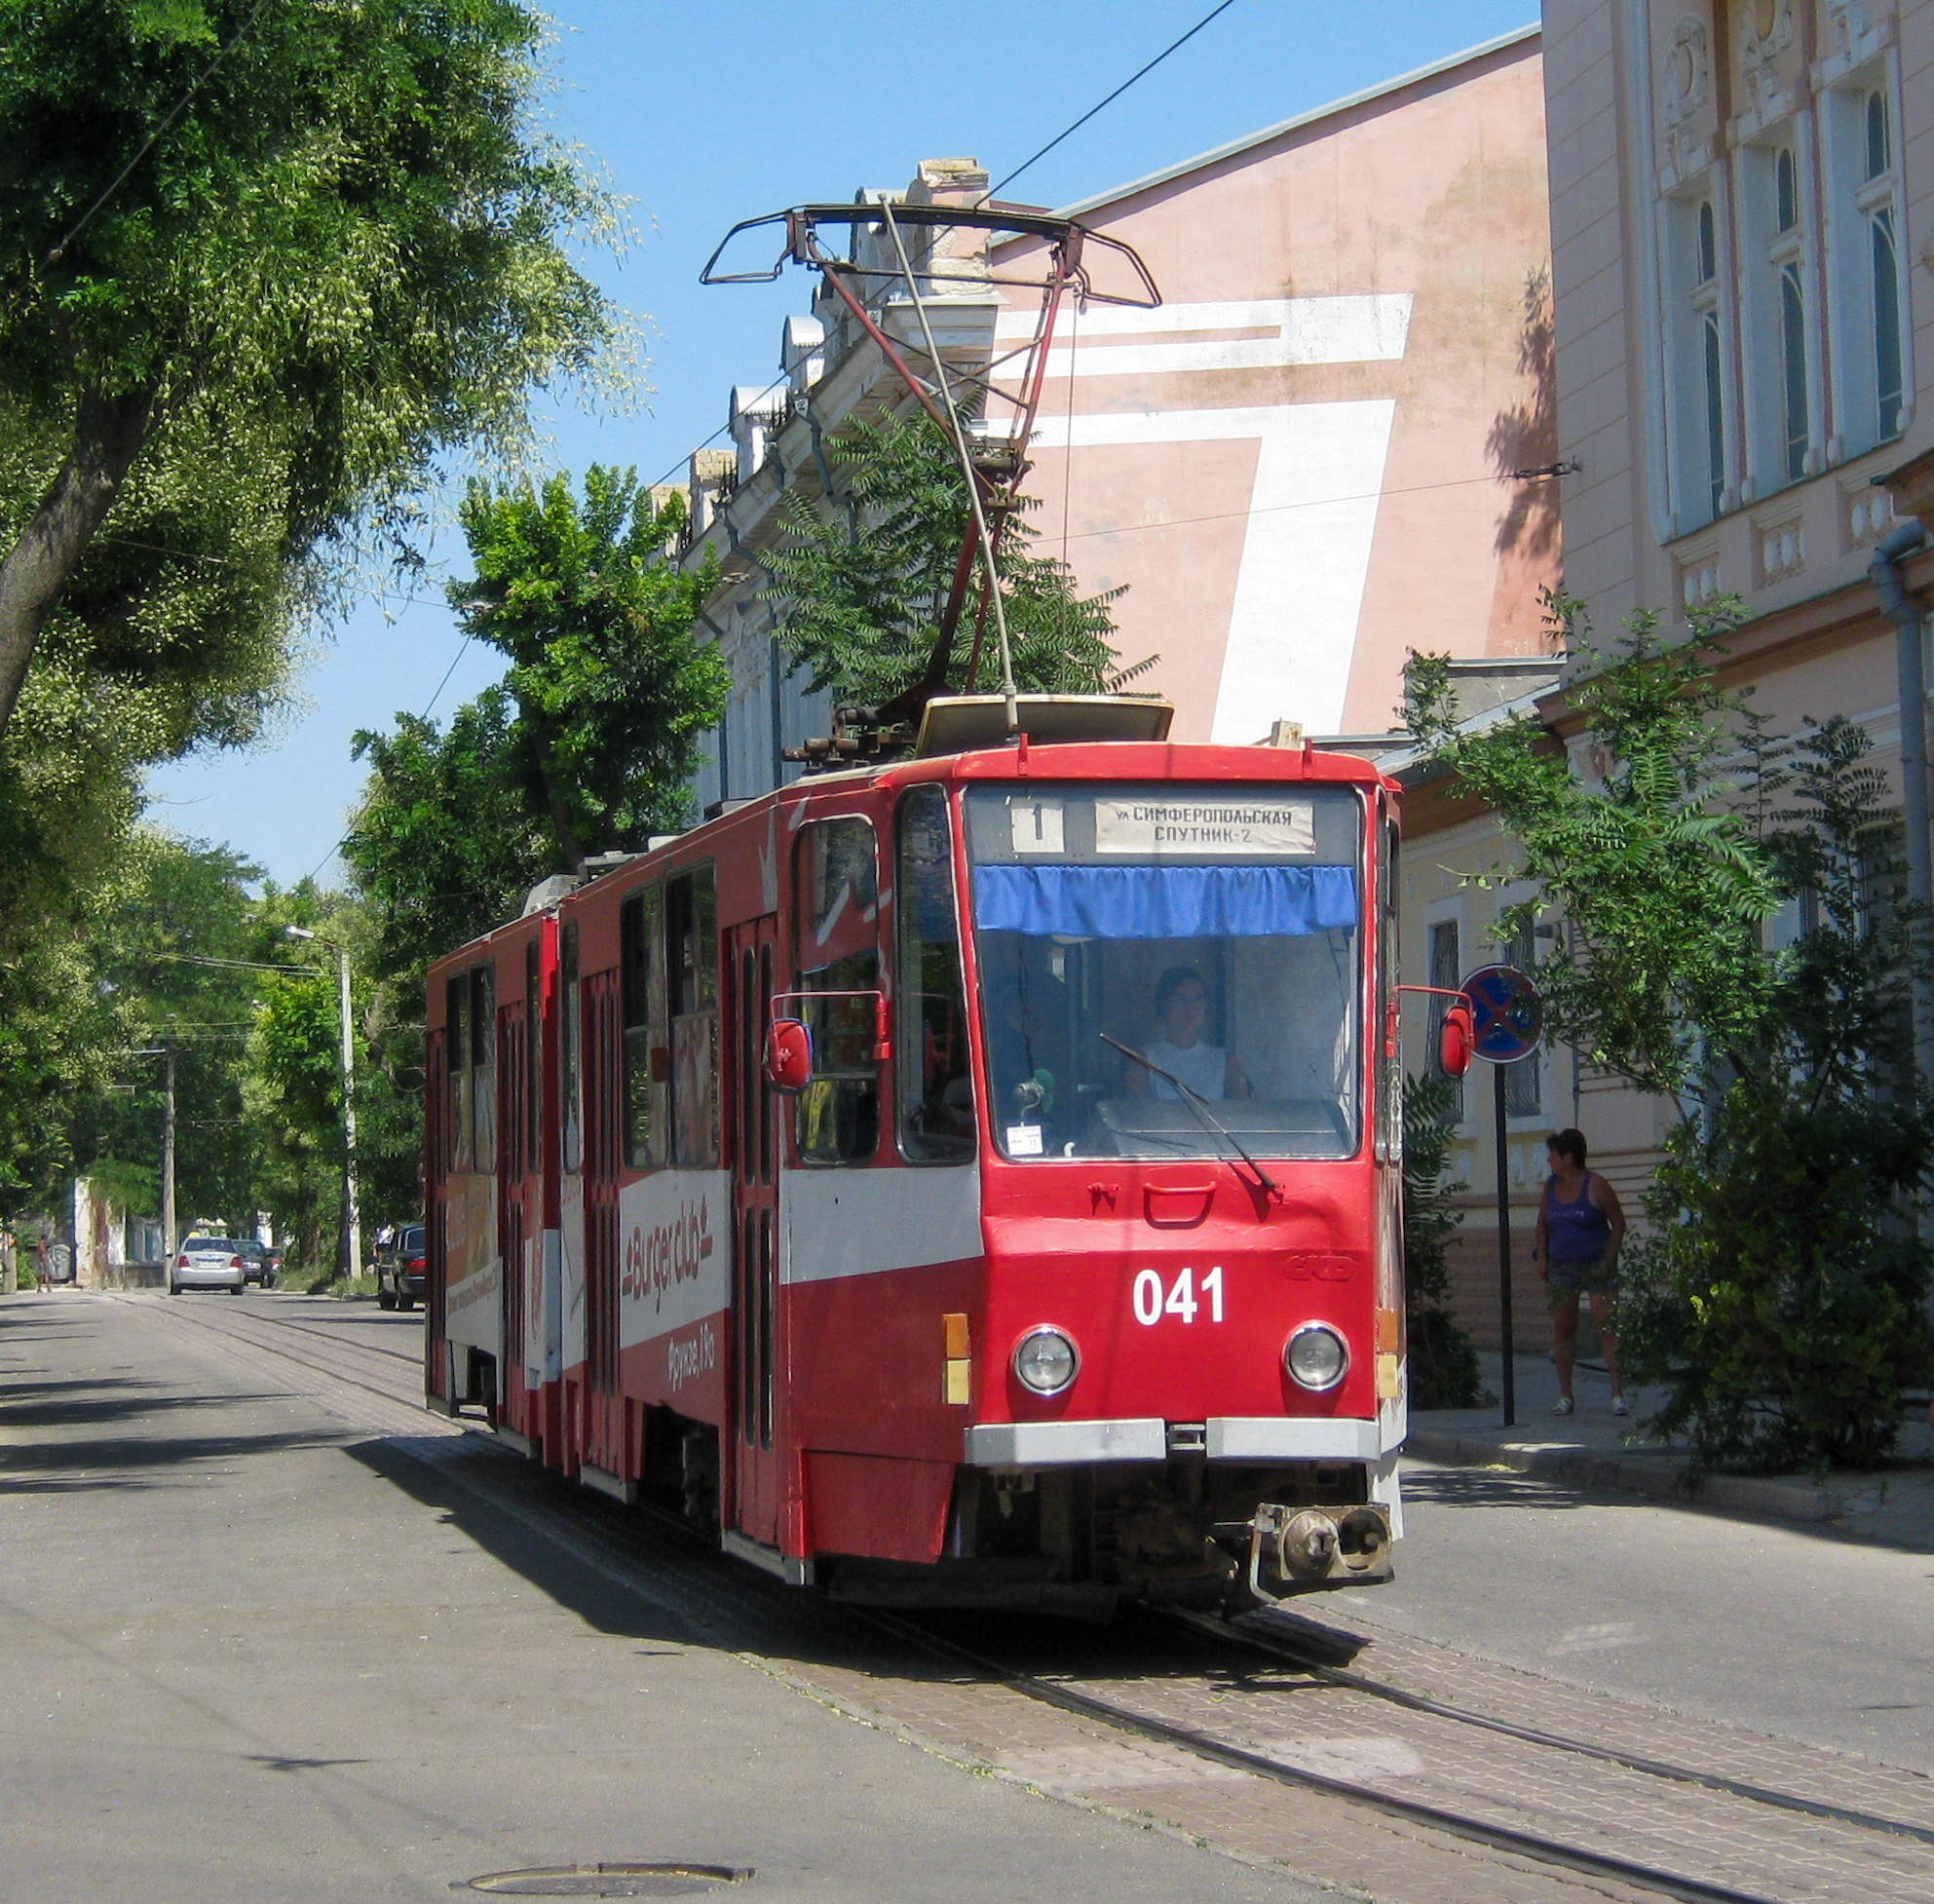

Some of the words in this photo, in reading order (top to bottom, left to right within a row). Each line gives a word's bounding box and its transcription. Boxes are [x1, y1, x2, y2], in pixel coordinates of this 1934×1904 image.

[1032, 803, 1043, 840] 1
[1133, 807, 1293, 826] СИМФЕРОПОЛЬСКАЯ
[1154, 827, 1253, 844] СПУТНИК-2
[1132, 1266, 1224, 1326] 041
